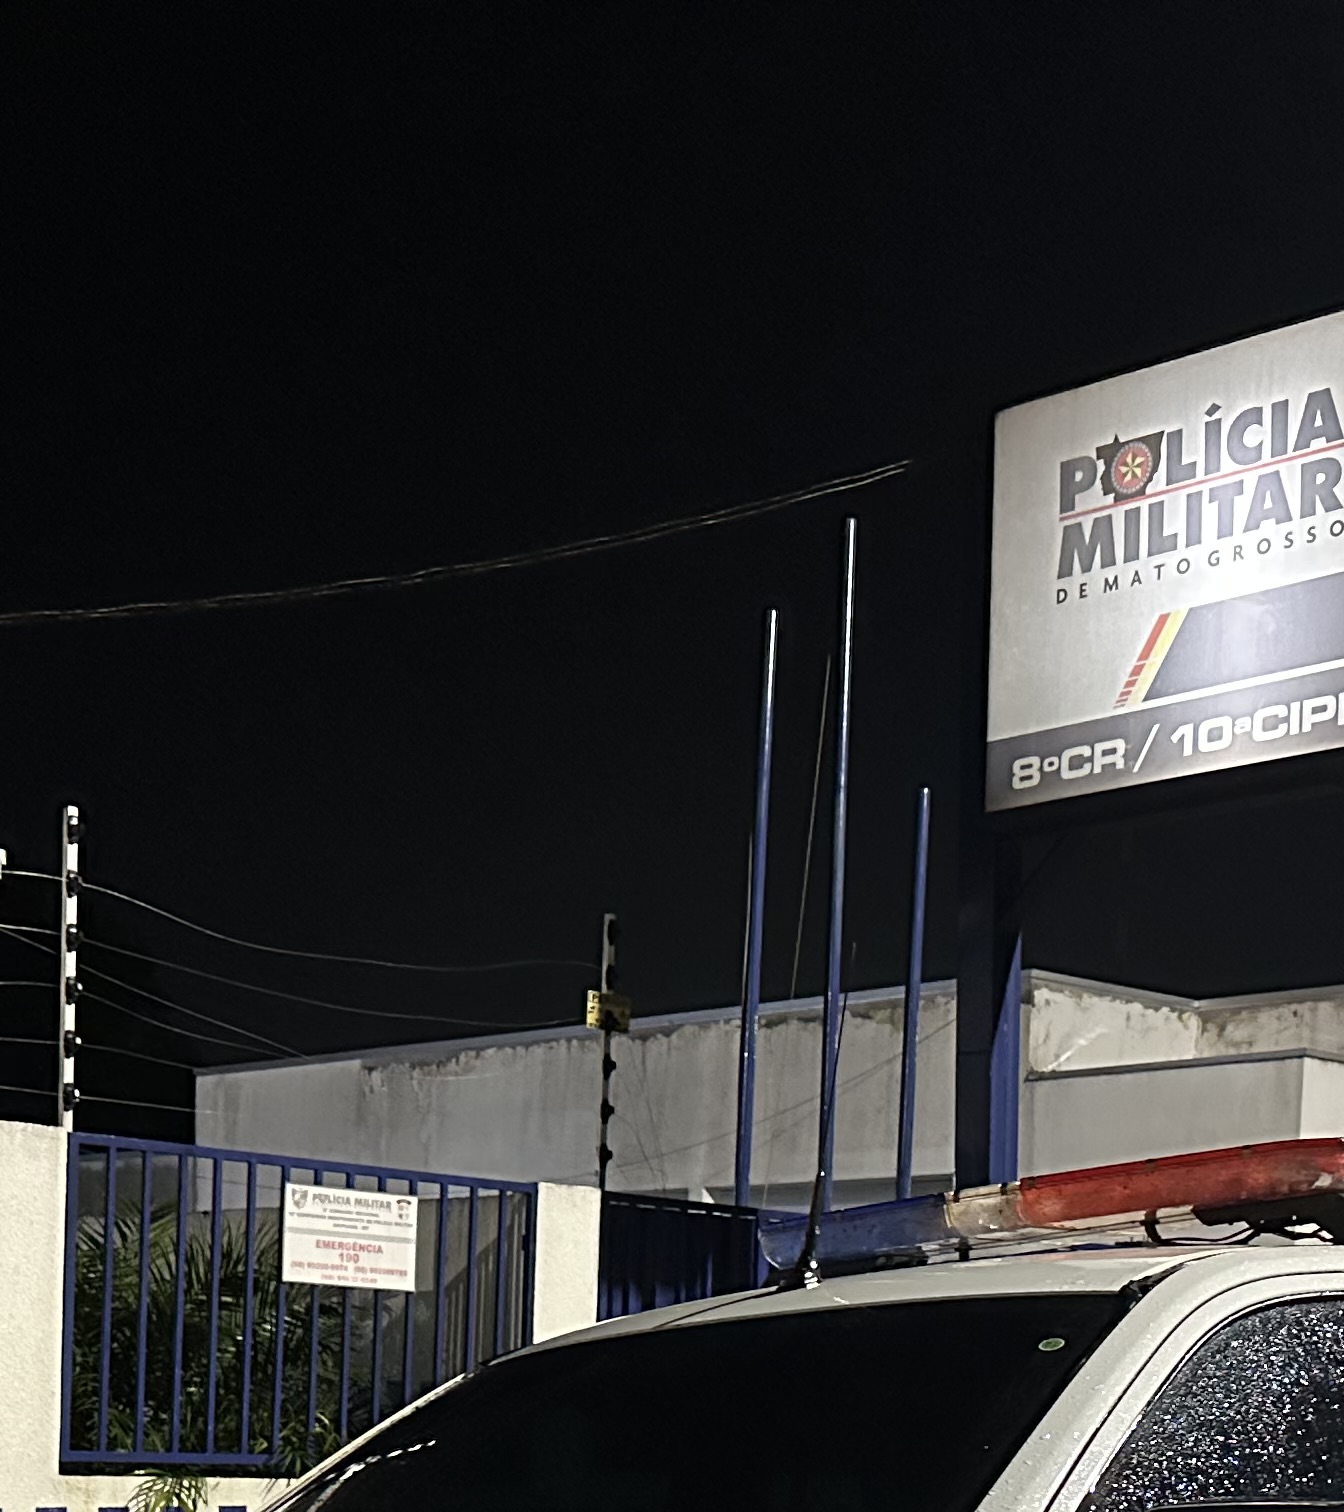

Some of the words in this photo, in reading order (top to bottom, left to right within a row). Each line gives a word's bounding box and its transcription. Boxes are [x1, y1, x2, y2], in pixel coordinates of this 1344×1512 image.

[1056, 456, 1344, 579] MILITAR
[1055, 582, 1089, 605] DE
[1103, 558, 1191, 594] MATO
[354, 1197, 392, 1210] MILITAR
[315, 1238, 384, 1255] EMERGÊNCIA
[338, 1252, 360, 1264] 190
